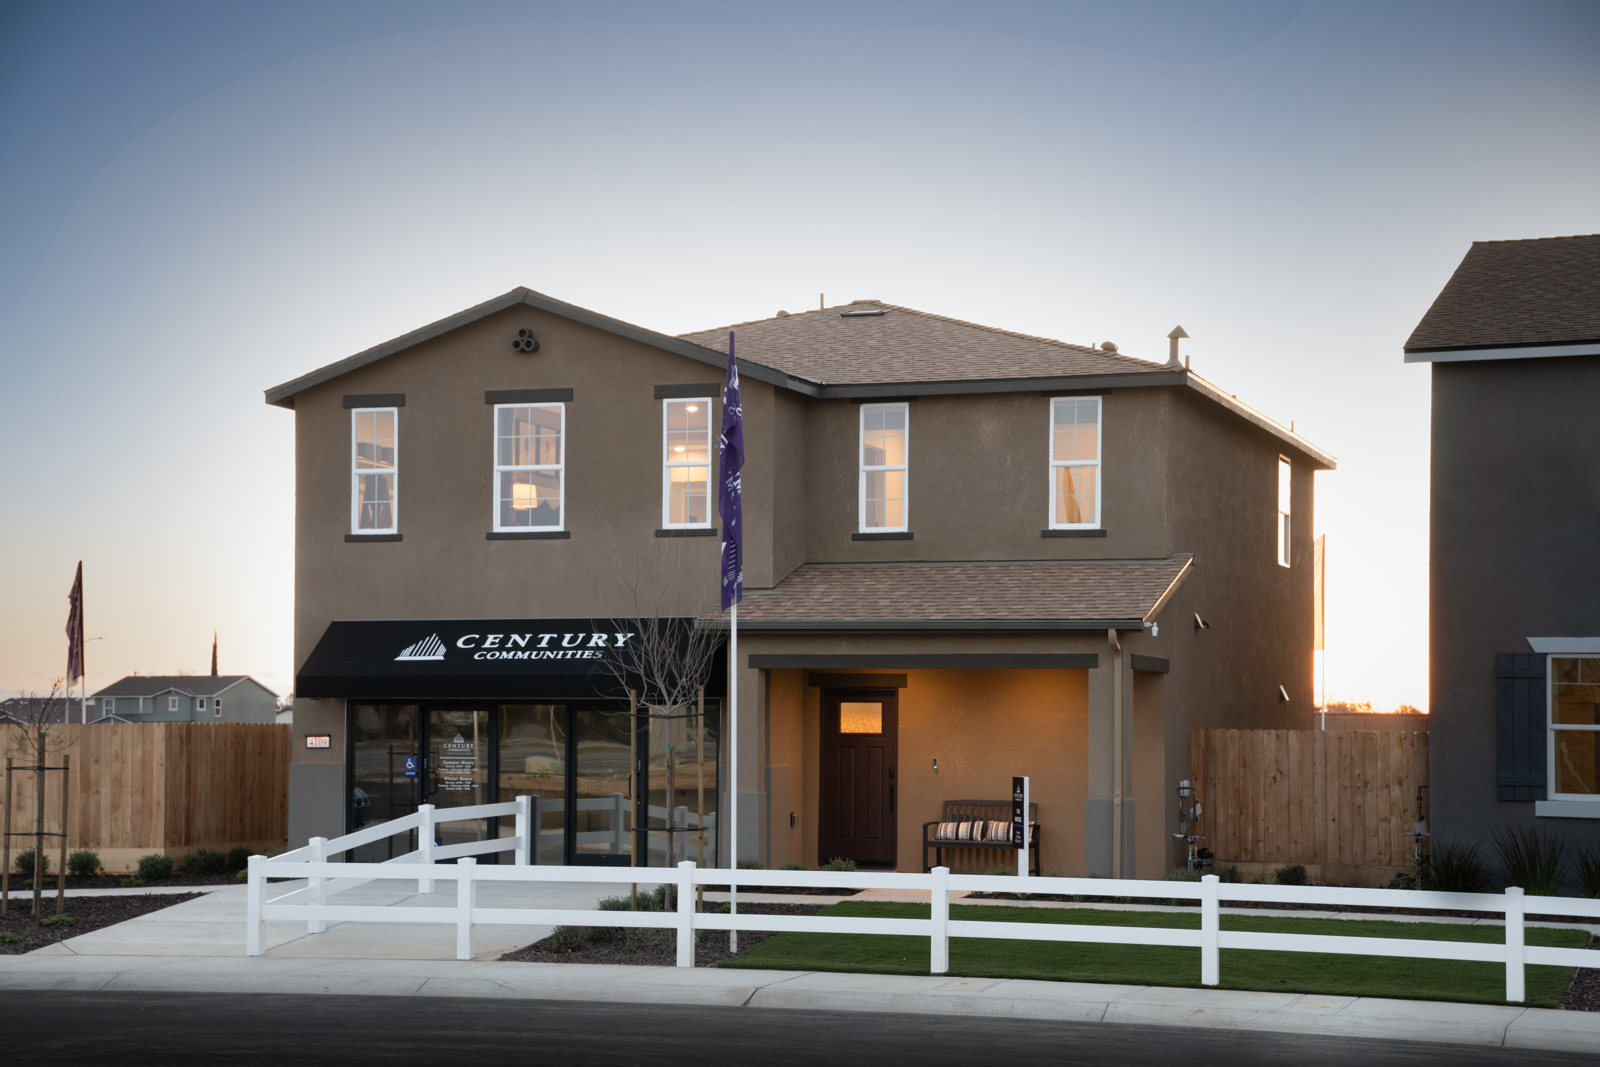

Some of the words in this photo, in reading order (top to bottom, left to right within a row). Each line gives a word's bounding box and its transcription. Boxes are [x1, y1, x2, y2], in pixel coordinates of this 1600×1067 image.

[456, 633, 635, 648] CENTURY
[473, 650, 604, 660] COMMUNITIES
[310, 738, 326, 747] 4109
